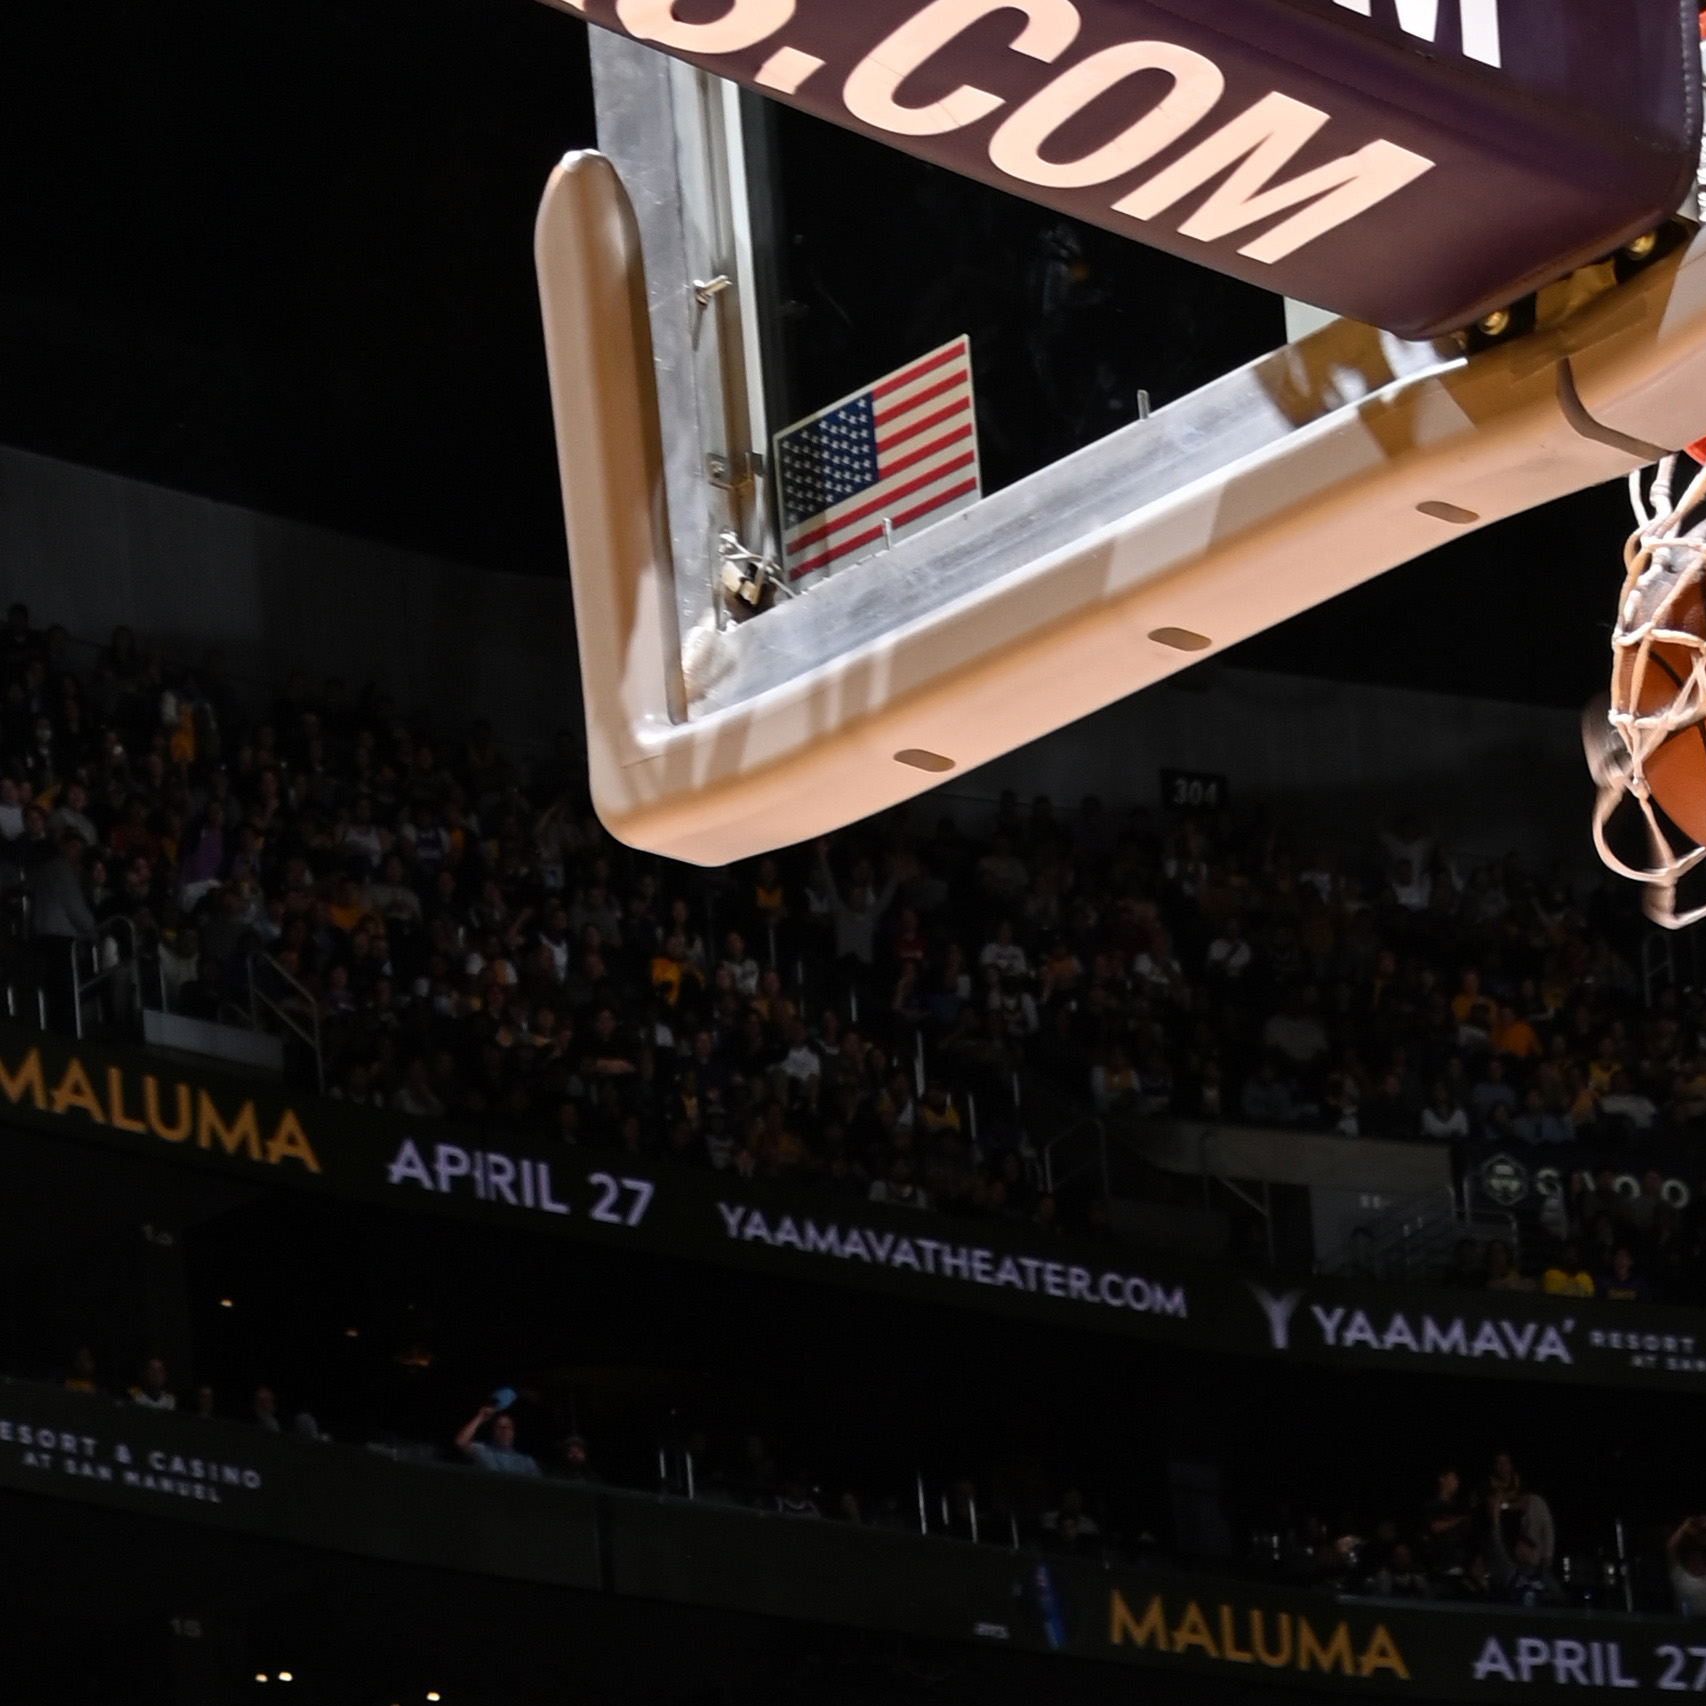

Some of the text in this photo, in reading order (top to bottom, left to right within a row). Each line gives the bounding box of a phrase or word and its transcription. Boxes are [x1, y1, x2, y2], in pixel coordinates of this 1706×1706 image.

[0, 1044, 322, 1175] MALUMA
[386, 1136, 571, 1217] APRIL
[587, 1169, 656, 1228] 27
[1108, 1588, 1412, 1681] MALUMA
[1472, 1635, 1641, 1690] APRIL
